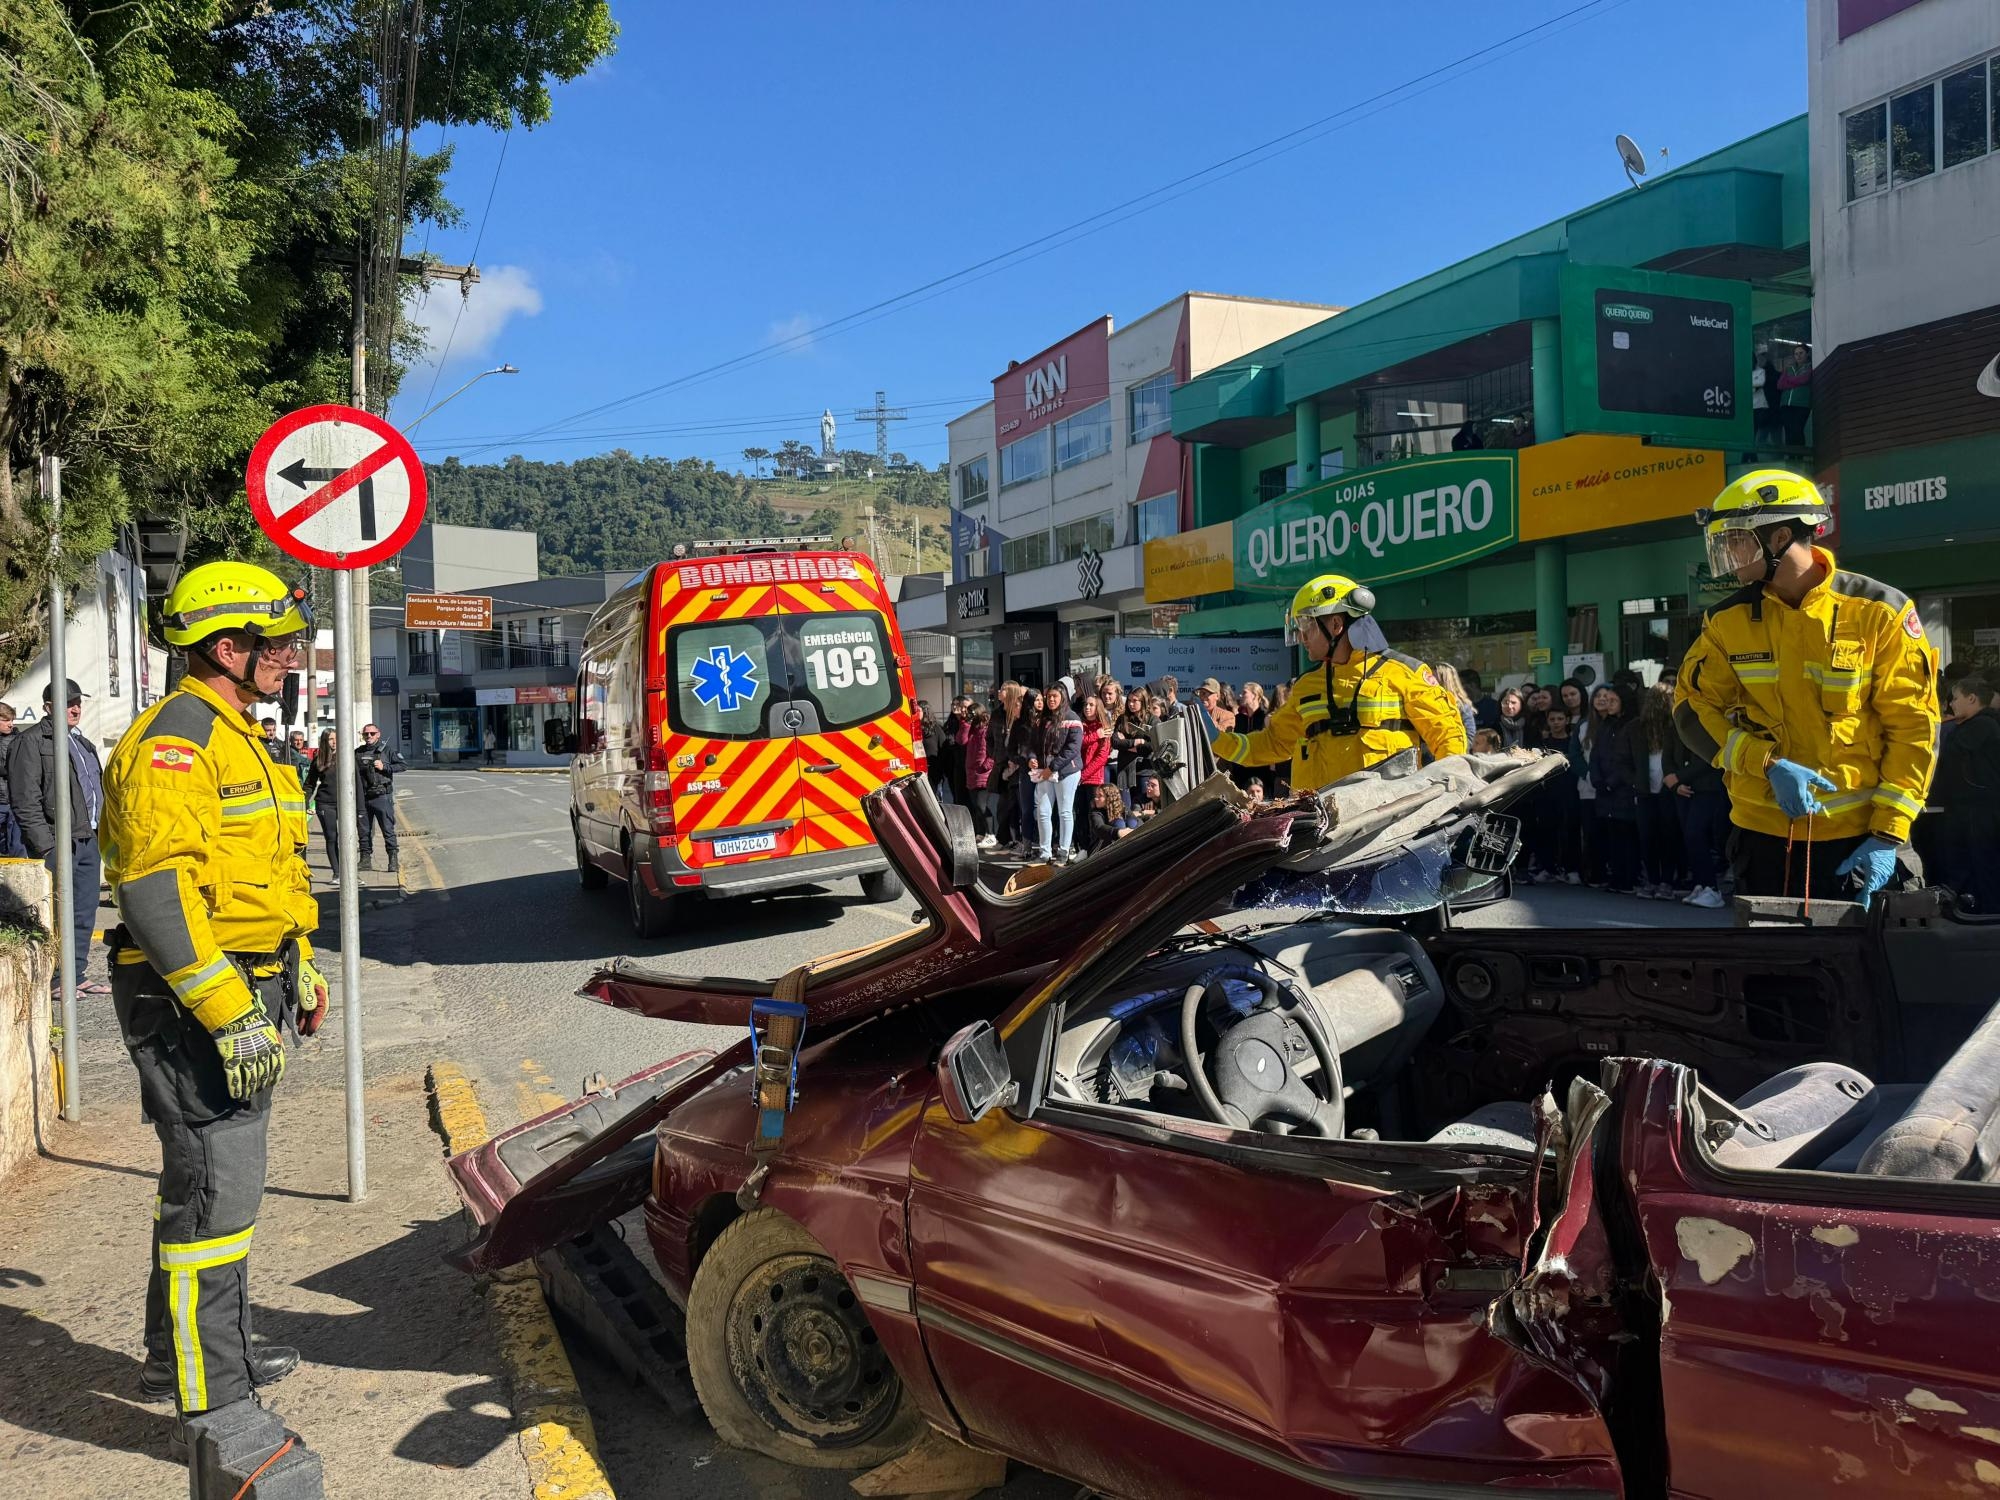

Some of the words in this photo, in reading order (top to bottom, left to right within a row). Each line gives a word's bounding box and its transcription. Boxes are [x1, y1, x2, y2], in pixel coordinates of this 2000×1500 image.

[1690, 315, 1728, 329] VerdeCard
[1025, 354, 1067, 412] KNN
[1703, 386, 1731, 407] elo
[1029, 398, 1064, 420] IDIOMAS
[1532, 483, 1561, 497] CASA
[1566, 481, 1573, 491] E
[1575, 469, 1611, 490] mais
[1613, 454, 1705, 481] CONSTRUÇÃO
[1335, 481, 1376, 504] LOJAS
[1864, 476, 1948, 511] ESPORTES
[678, 558, 857, 589] BOMBEIROS
[968, 588, 985, 609] MIX
[803, 631, 874, 647] EMERGÊNCIA
[1125, 645, 1150, 654] Incepa
[1168, 645, 1189, 655] deca
[1735, 653, 1764, 661] MARTINS
[806, 645, 879, 690] 193
[1252, 662, 1279, 672] Consul
[687, 779, 722, 792] ASU-435
[720, 837, 769, 854] QHW2C49
